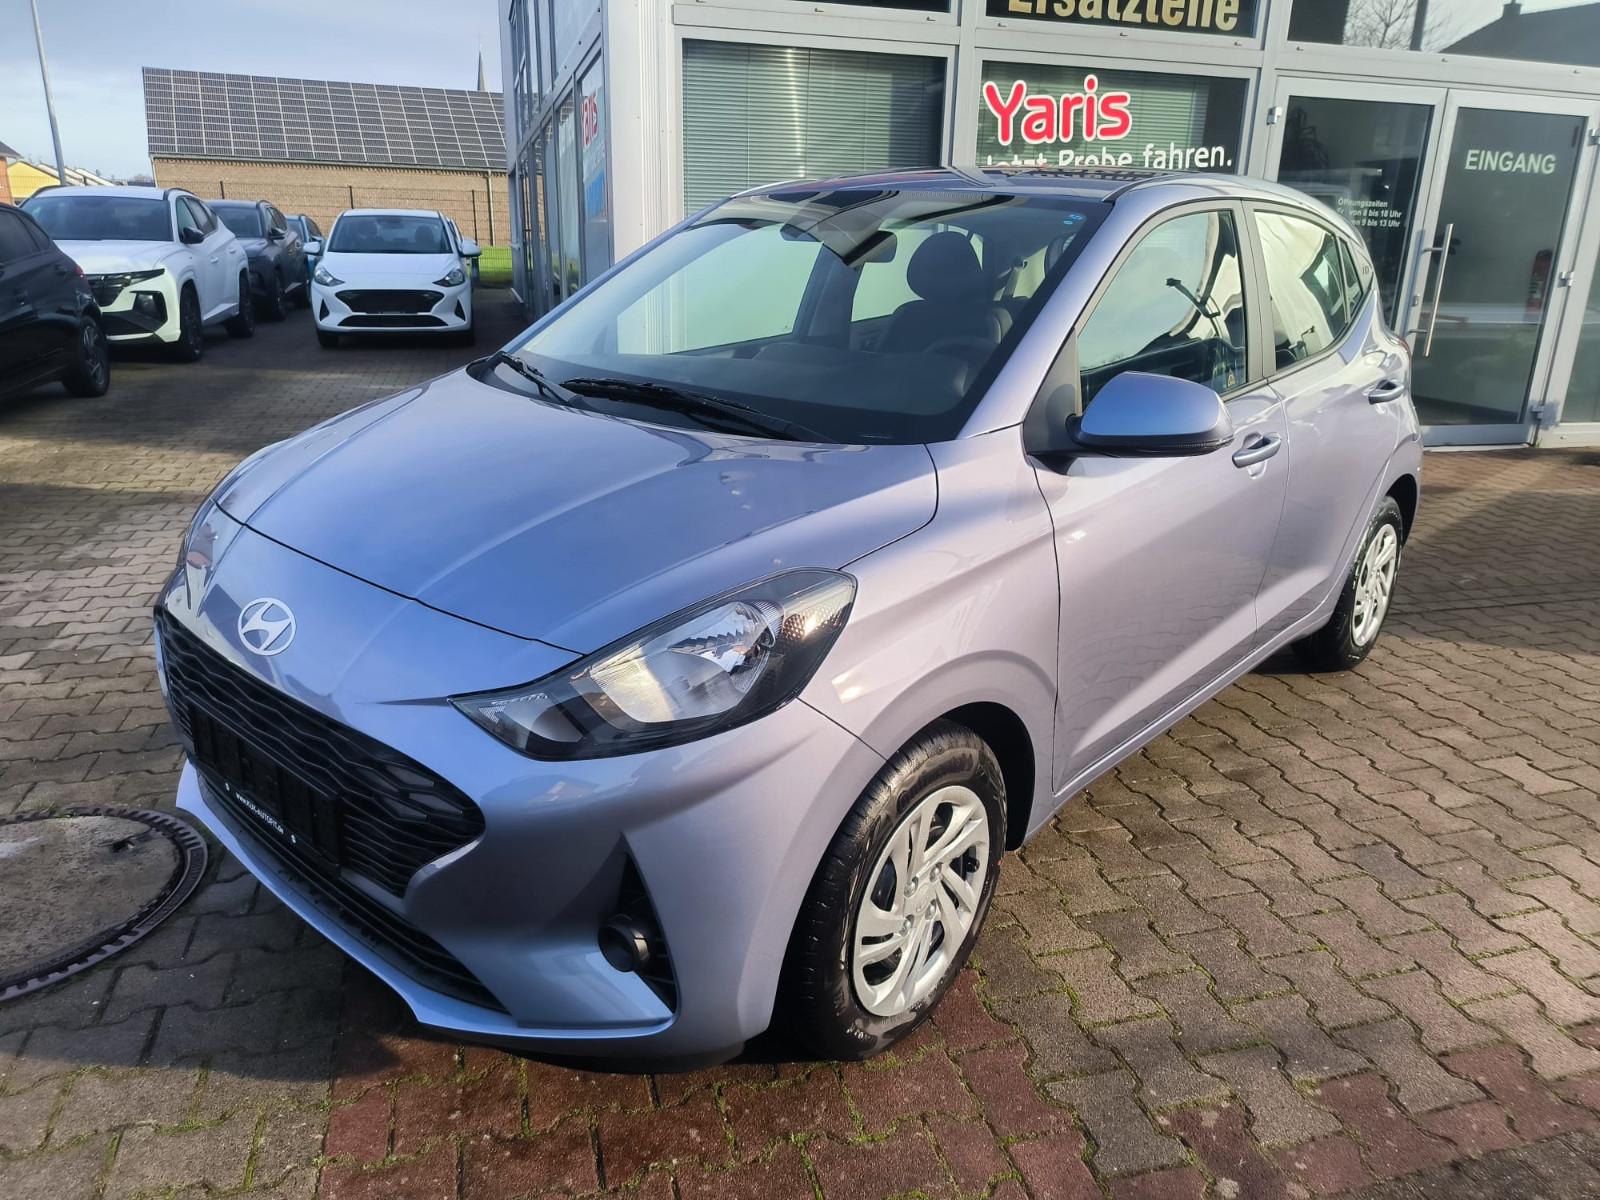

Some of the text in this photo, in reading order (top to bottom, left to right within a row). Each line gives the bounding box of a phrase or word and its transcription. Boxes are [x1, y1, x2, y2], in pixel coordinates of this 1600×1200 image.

[983, 75, 1132, 145] Yaris
[1143, 142, 1232, 170] fahren.
[1464, 149, 1556, 174] EINGANG
[1389, 210, 1402, 218] Uhr
